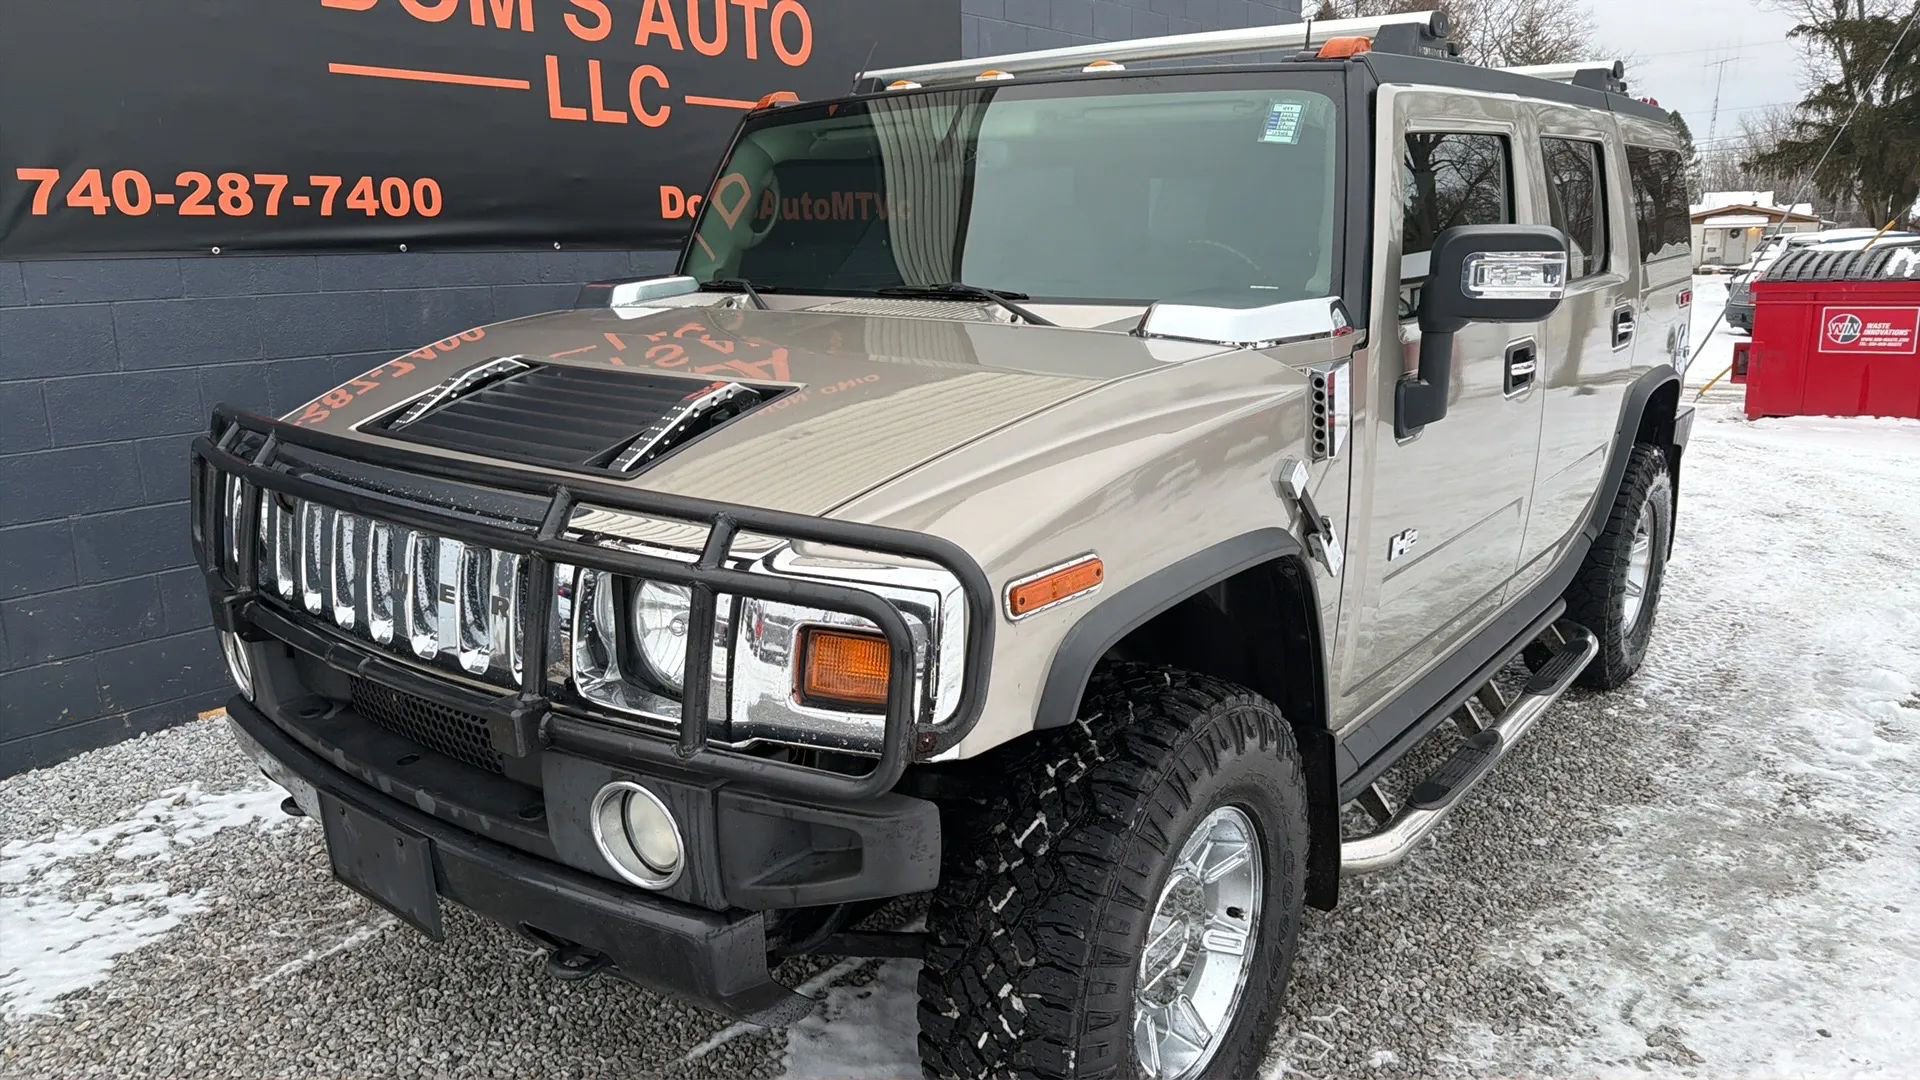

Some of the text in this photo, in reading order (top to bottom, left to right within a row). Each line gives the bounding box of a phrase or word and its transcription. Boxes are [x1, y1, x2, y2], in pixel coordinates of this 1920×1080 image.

[635, 0, 813, 67] AUTO
[546, 55, 671, 128] LLC
[16, 167, 444, 217] 740-287-7400
[1830, 322, 1860, 335] WIN
[1387, 528, 1418, 561] H2
